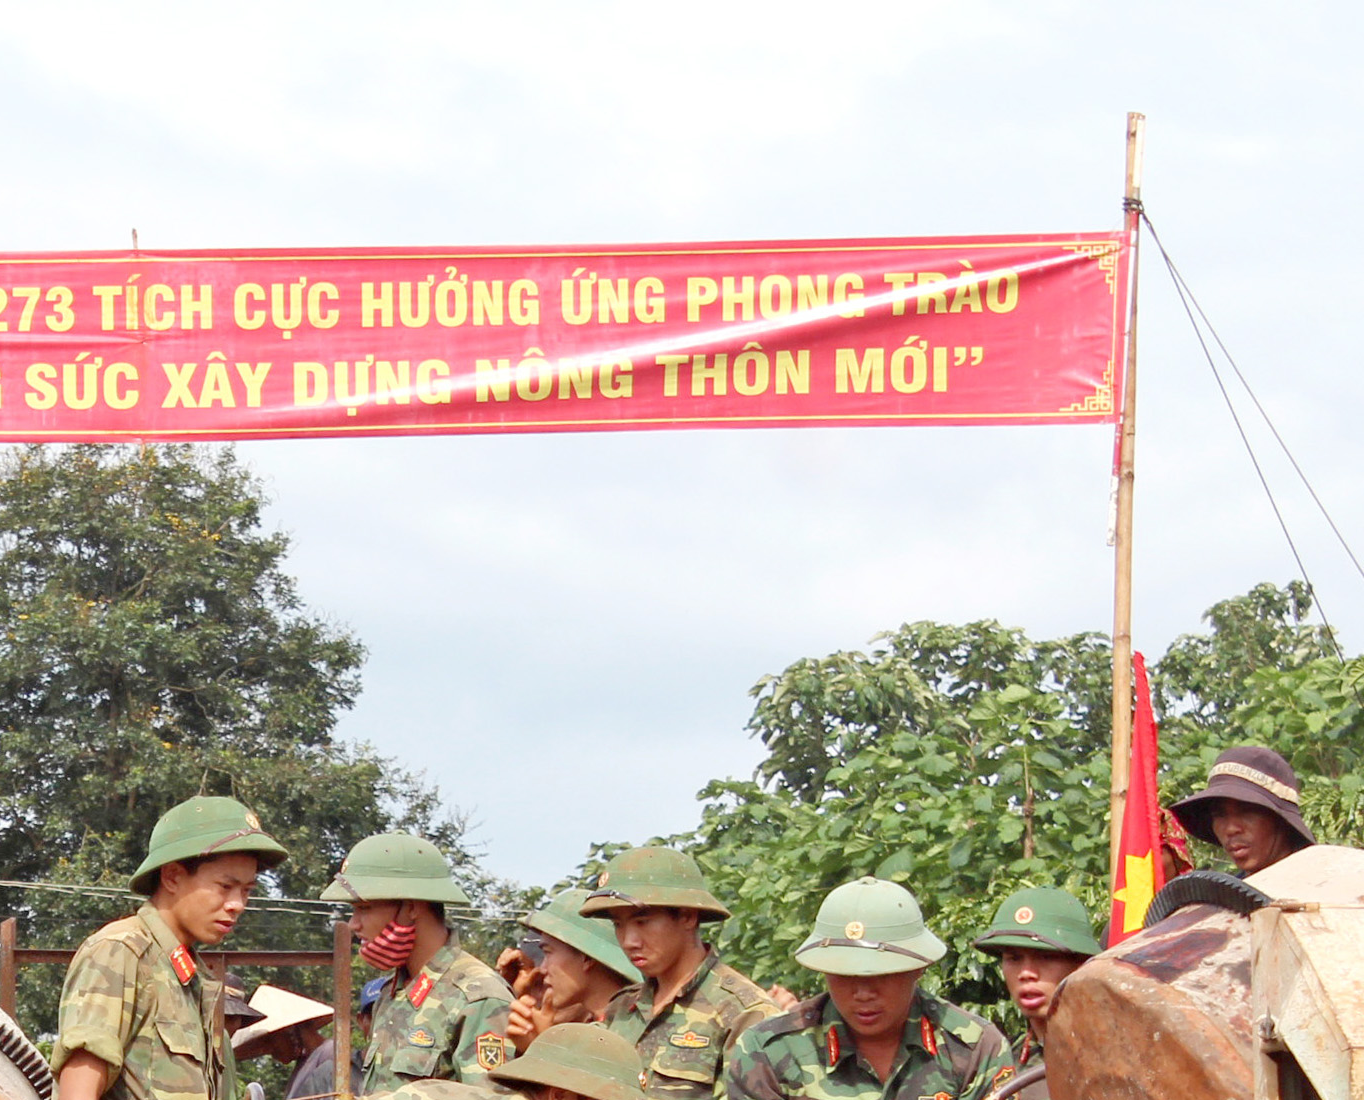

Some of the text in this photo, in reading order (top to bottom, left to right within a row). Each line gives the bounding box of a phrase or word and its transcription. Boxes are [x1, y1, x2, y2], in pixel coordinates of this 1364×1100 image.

[93, 274, 213, 331] TÍCH
[235, 277, 340, 339] CỰC
[362, 267, 540, 327] HƯỞNG
[562, 268, 666, 325] ỨNG
[687, 274, 865, 322] PHONG
[884, 260, 1020, 317] TRÀO
[26, 352, 140, 409] SỨC
[163, 352, 272, 408] XÂY
[294, 355, 452, 416] DỰNG
[476, 348, 634, 402] NÔNG
[656, 342, 811, 396] THÔN
